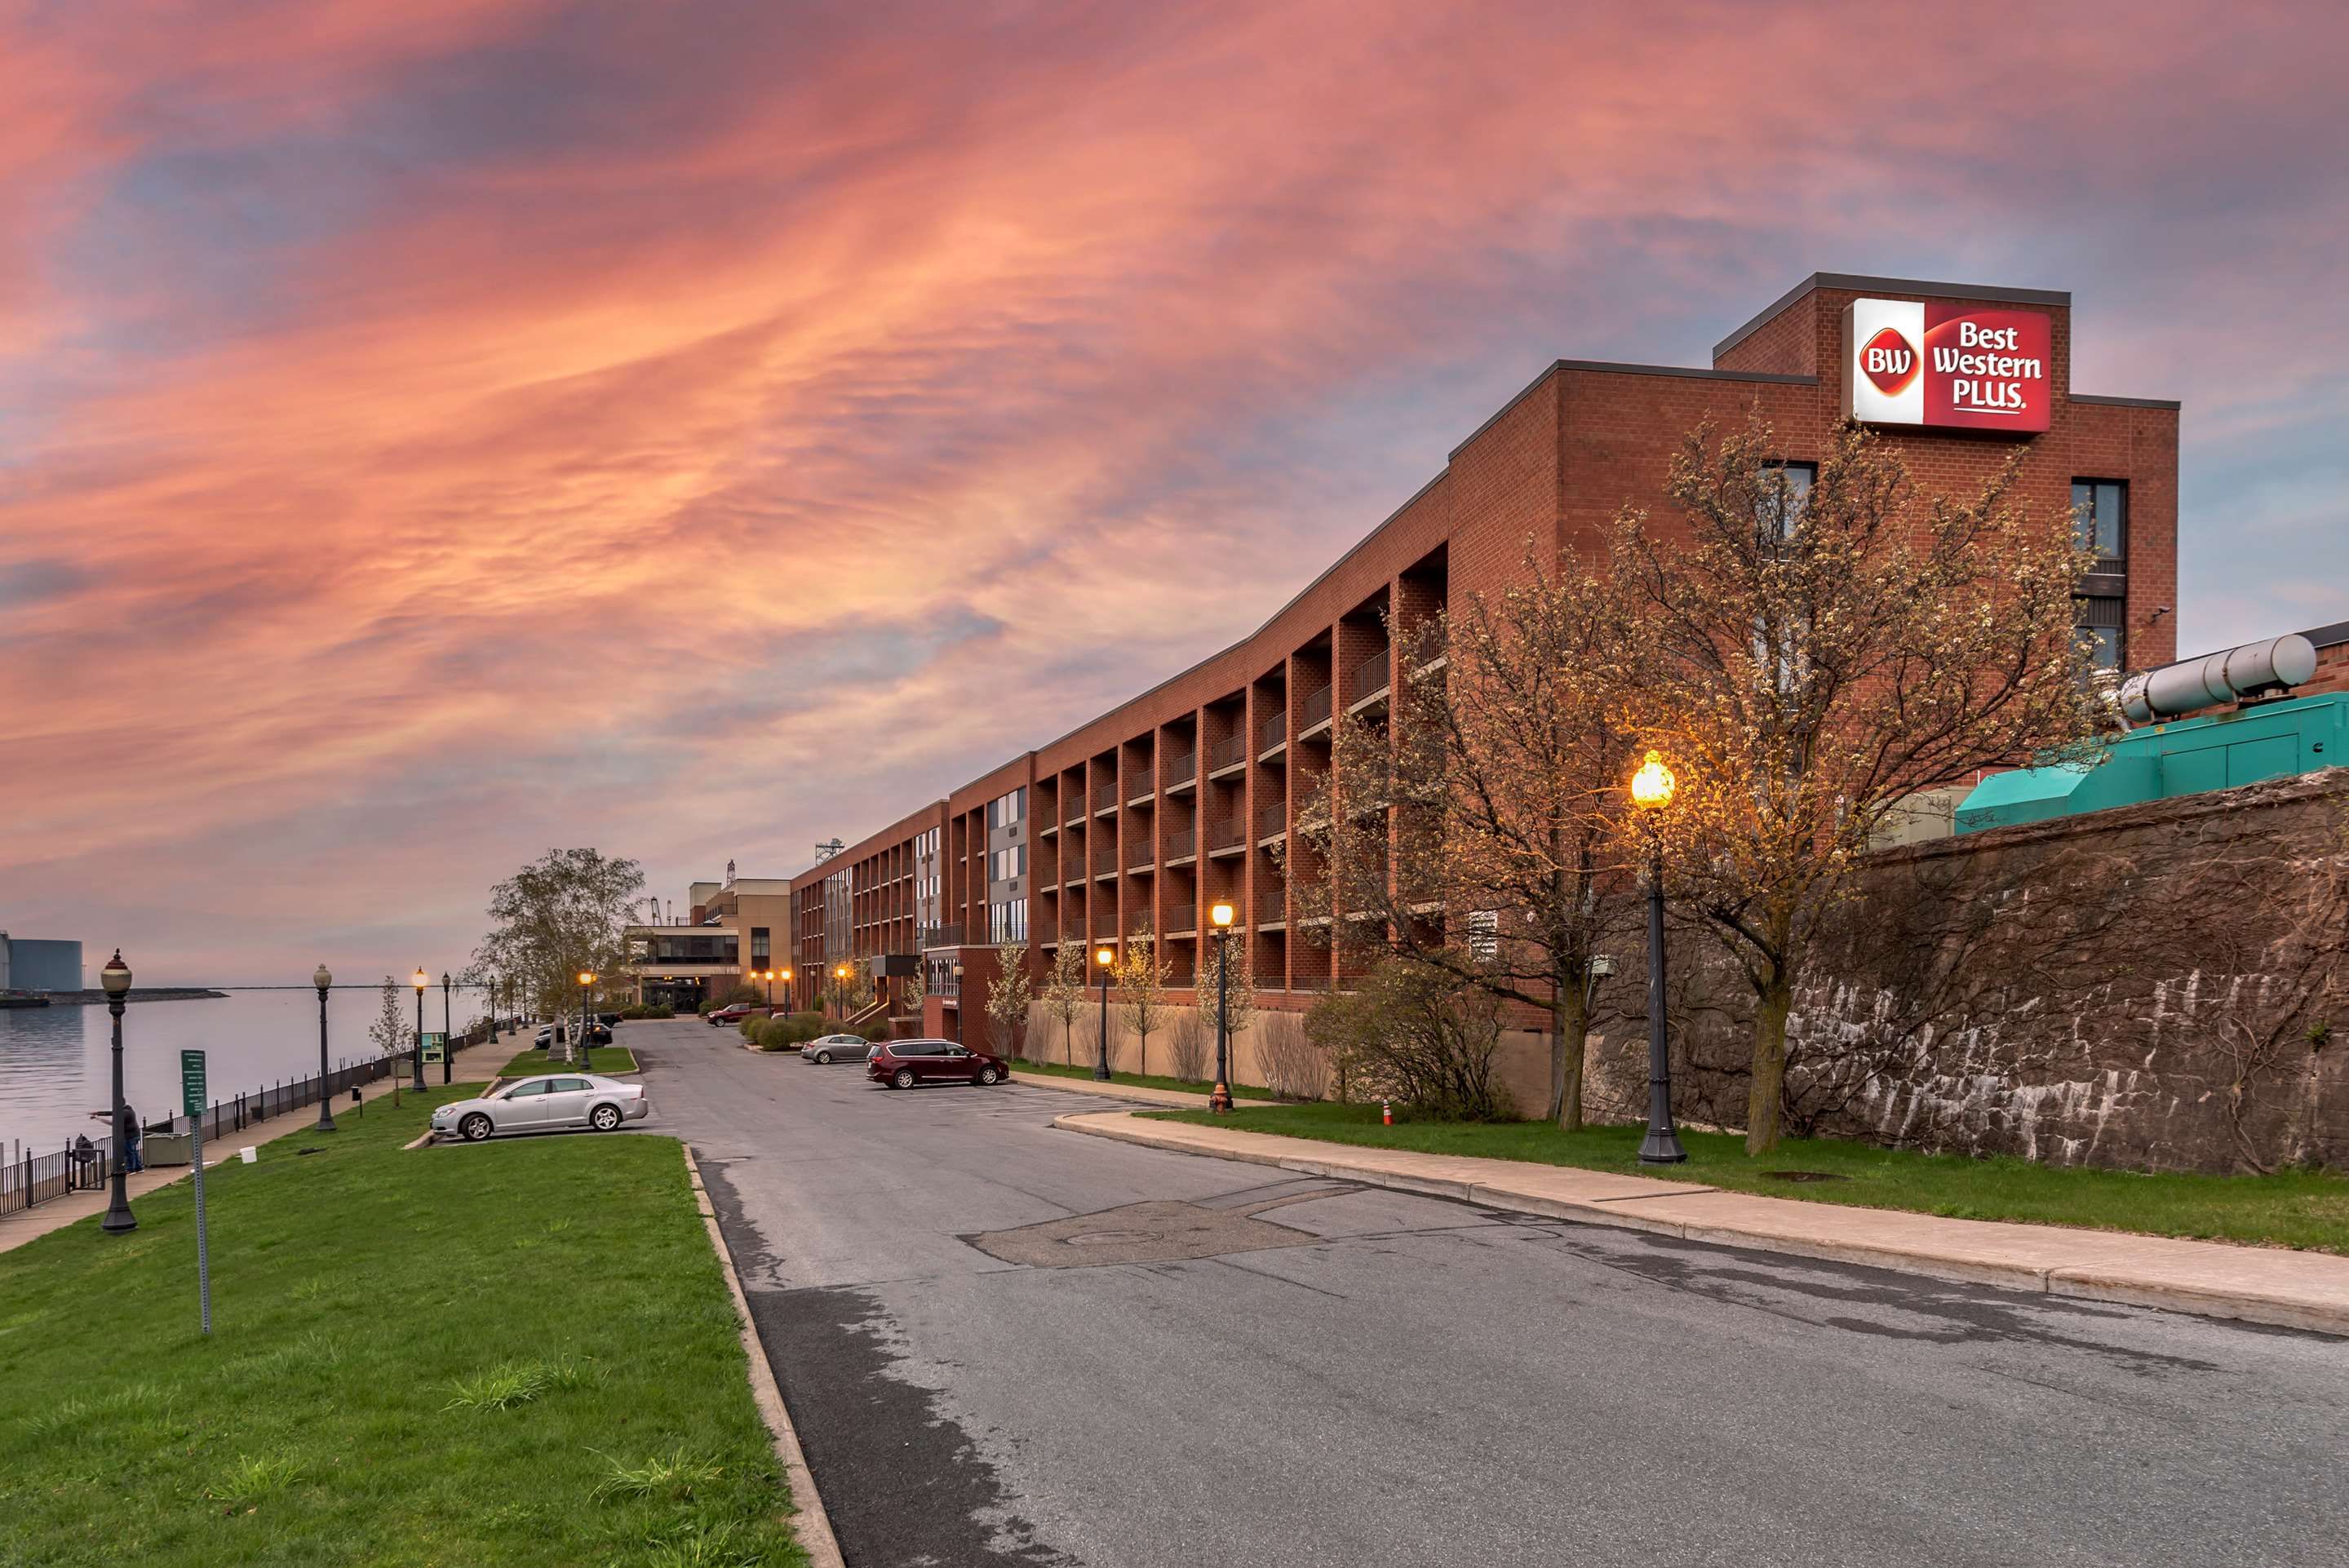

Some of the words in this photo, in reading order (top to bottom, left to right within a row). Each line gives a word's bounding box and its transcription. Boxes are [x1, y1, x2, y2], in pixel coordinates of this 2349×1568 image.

[1960, 321, 2019, 351] Best
[1868, 348, 1912, 374] BW
[1933, 347, 2042, 379] Western
